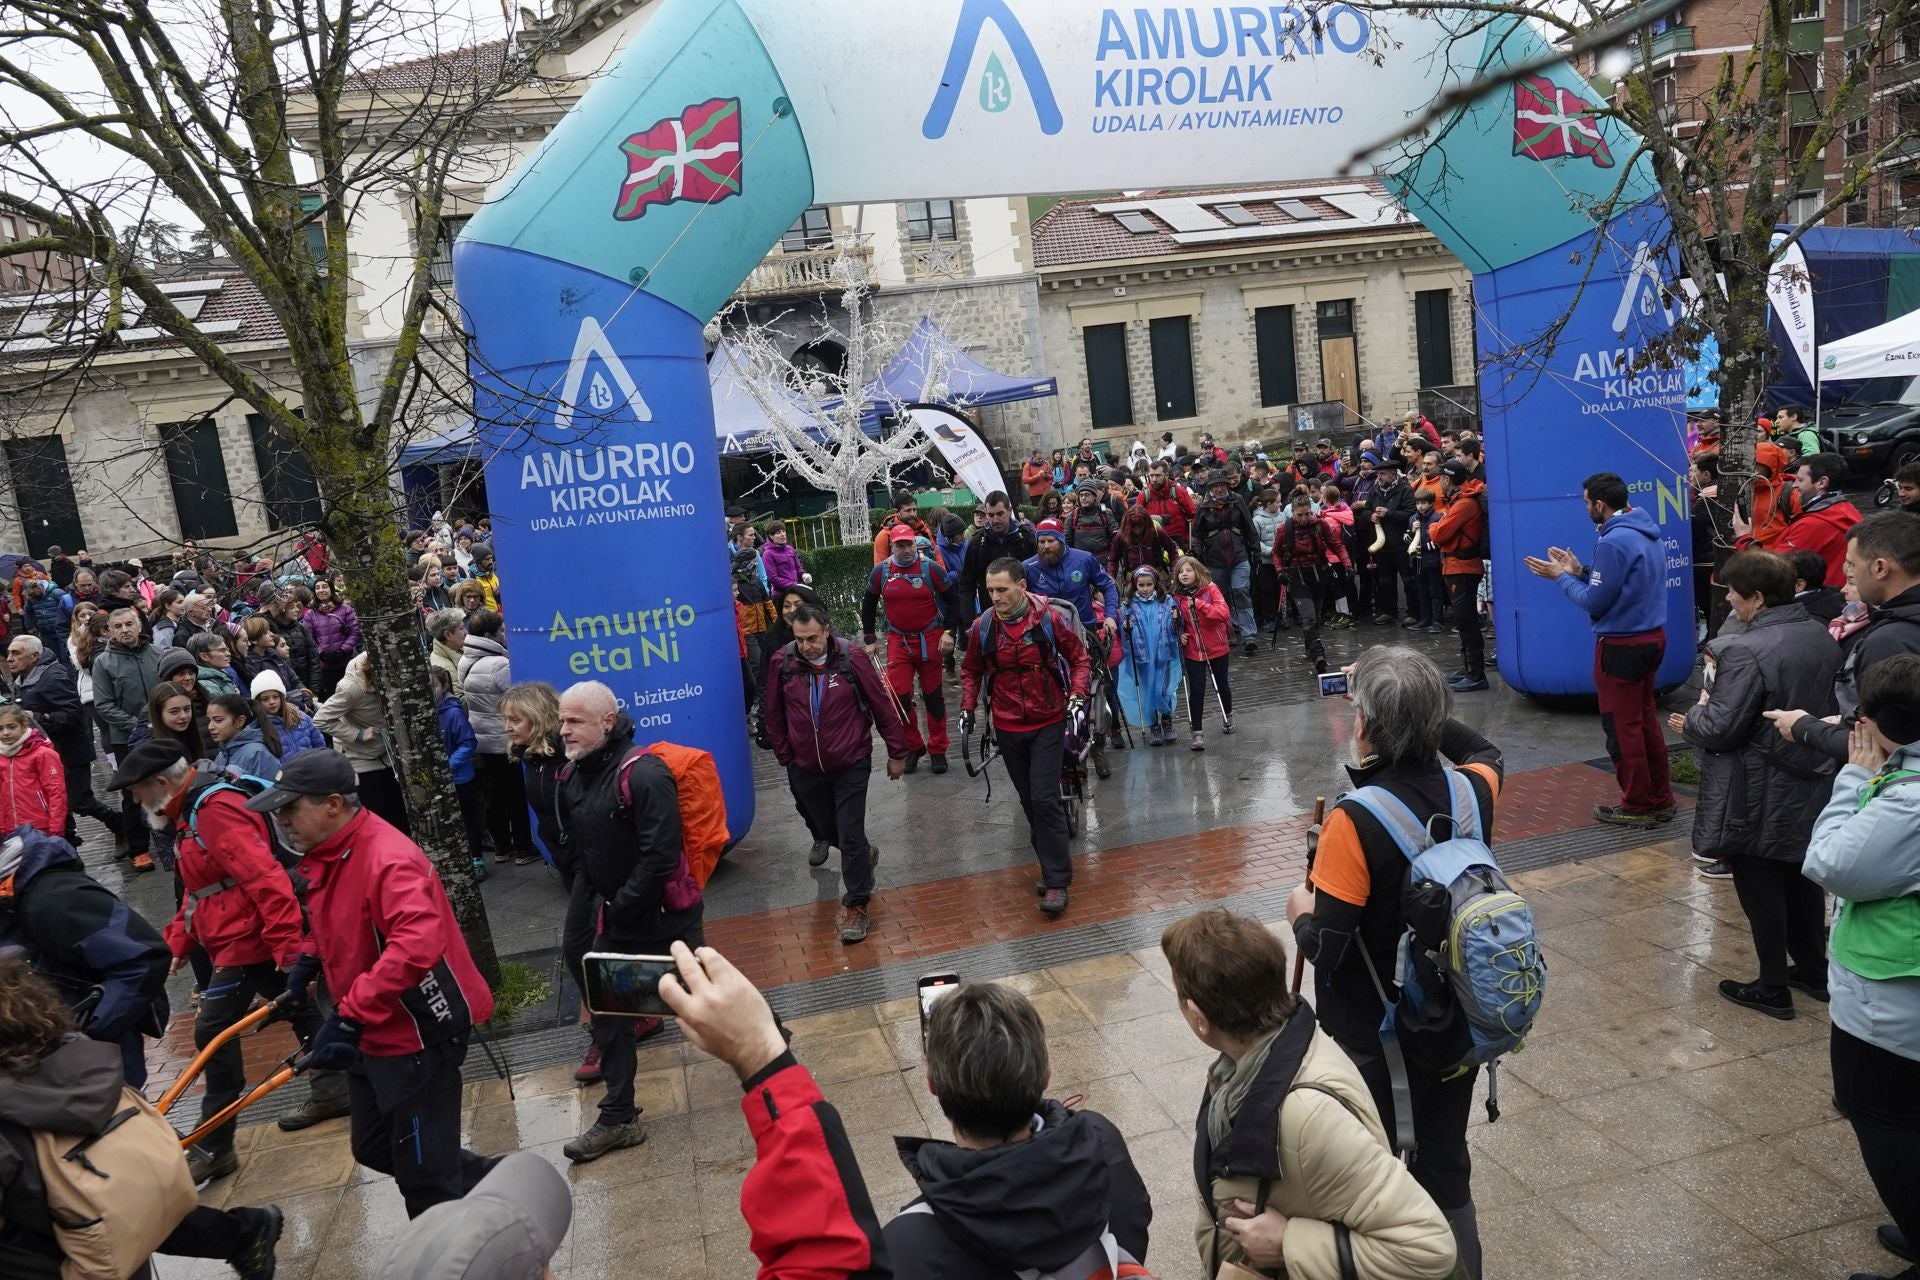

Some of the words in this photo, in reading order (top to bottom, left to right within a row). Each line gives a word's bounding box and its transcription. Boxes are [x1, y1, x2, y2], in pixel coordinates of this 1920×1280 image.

[1095, 4, 1369, 61] AMURRIO
[1094, 65, 1273, 108] KIROLAK
[1092, 113, 1164, 134] UDALA
[1179, 106, 1343, 132] AYUNTAMIENTO
[1604, 374, 1682, 399] KIROLAK
[1582, 401, 1625, 414] UDALA
[520, 441, 694, 490] AMURRIO
[551, 480, 673, 512] KIROLAK
[1627, 479, 1652, 494] eta
[1657, 474, 1688, 525] Ni
[531, 515, 576, 531] UDALA
[586, 504, 695, 526] AYUNTAMIENTO
[549, 597, 695, 642] Amurrio
[569, 643, 633, 675] eta
[641, 631, 680, 667] Ni
[634, 682, 703, 707] bizitzeko
[640, 713, 672, 728] ona
